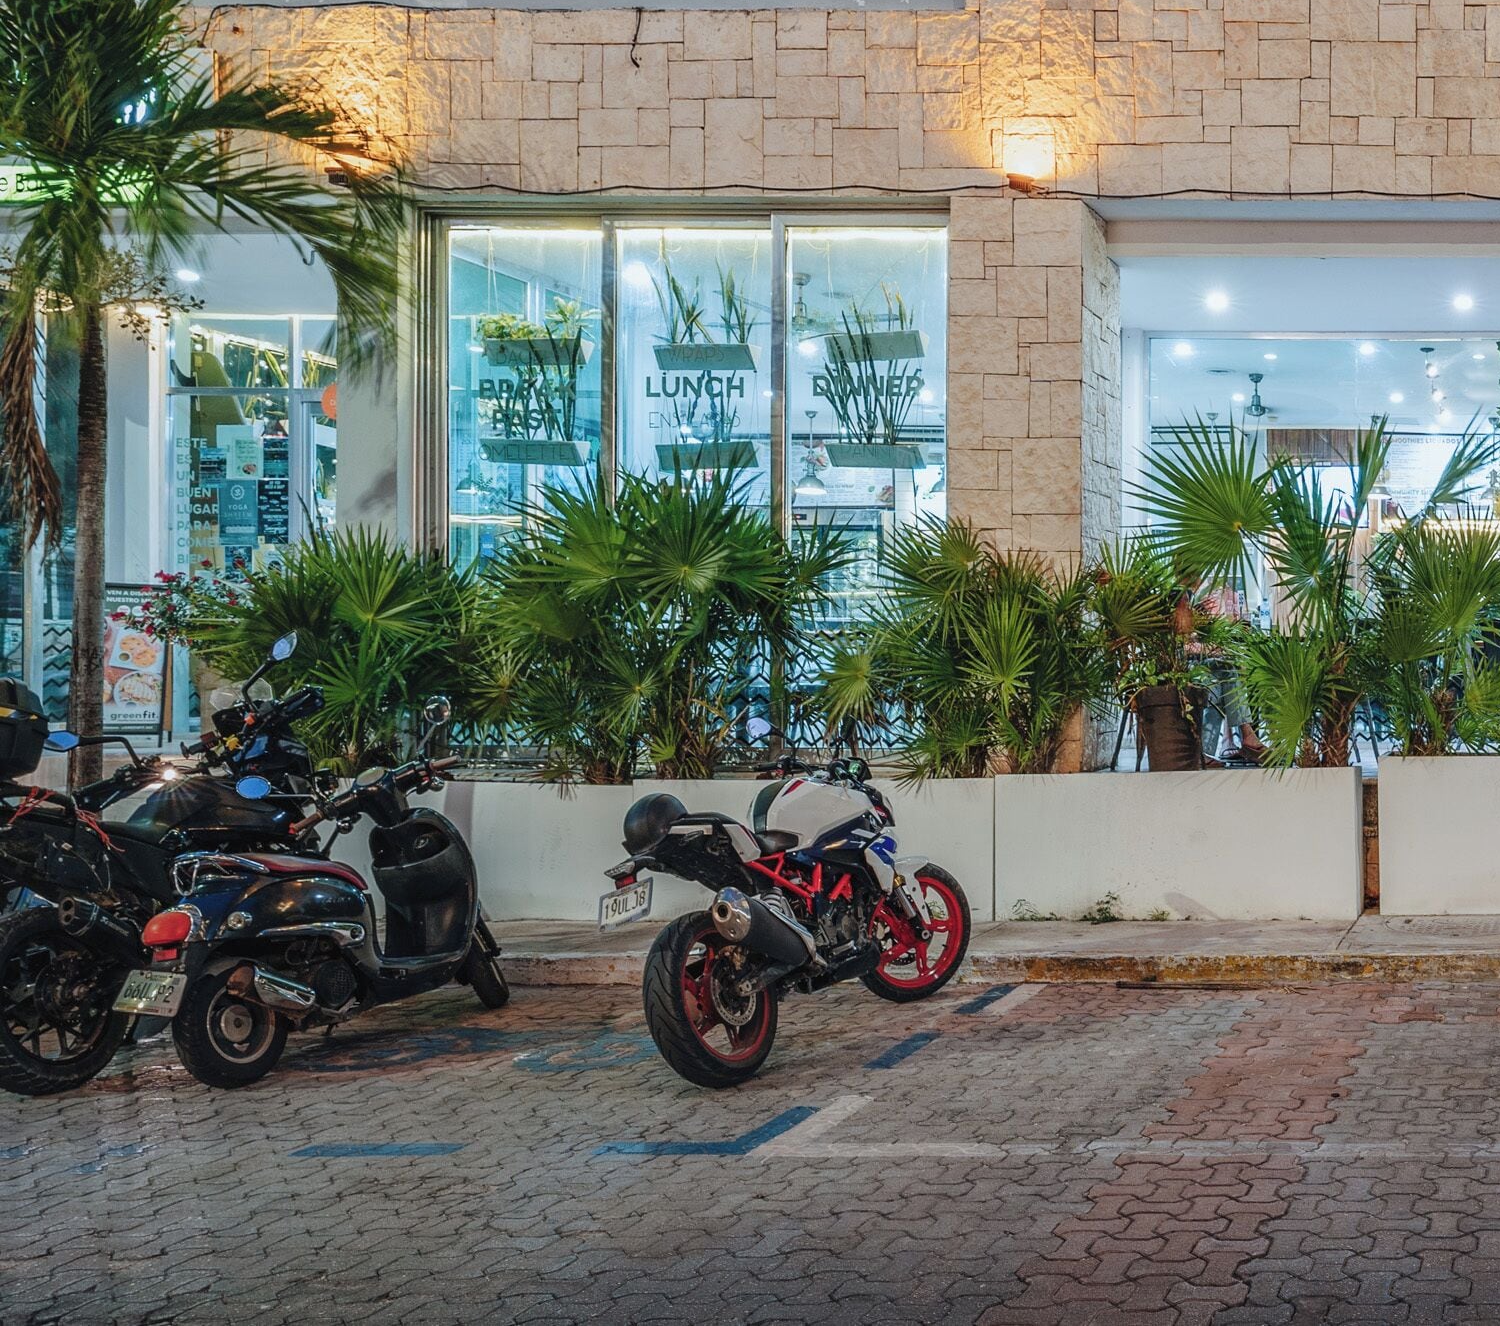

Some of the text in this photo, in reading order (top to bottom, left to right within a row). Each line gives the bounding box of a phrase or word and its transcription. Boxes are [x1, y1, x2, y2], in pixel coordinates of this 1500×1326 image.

[667, 345, 725, 362] WRAPS
[646, 376, 744, 398] LUNCH
[812, 375, 922, 397] DINNER
[176, 437, 208, 448] ESTE
[176, 454, 193, 465] ES
[176, 470, 195, 482] UN
[176, 487, 212, 498] BUEN
[176, 504, 220, 515] LUGAR
[176, 520, 212, 531] PARA
[106, 596, 140, 604] NUESTRO
